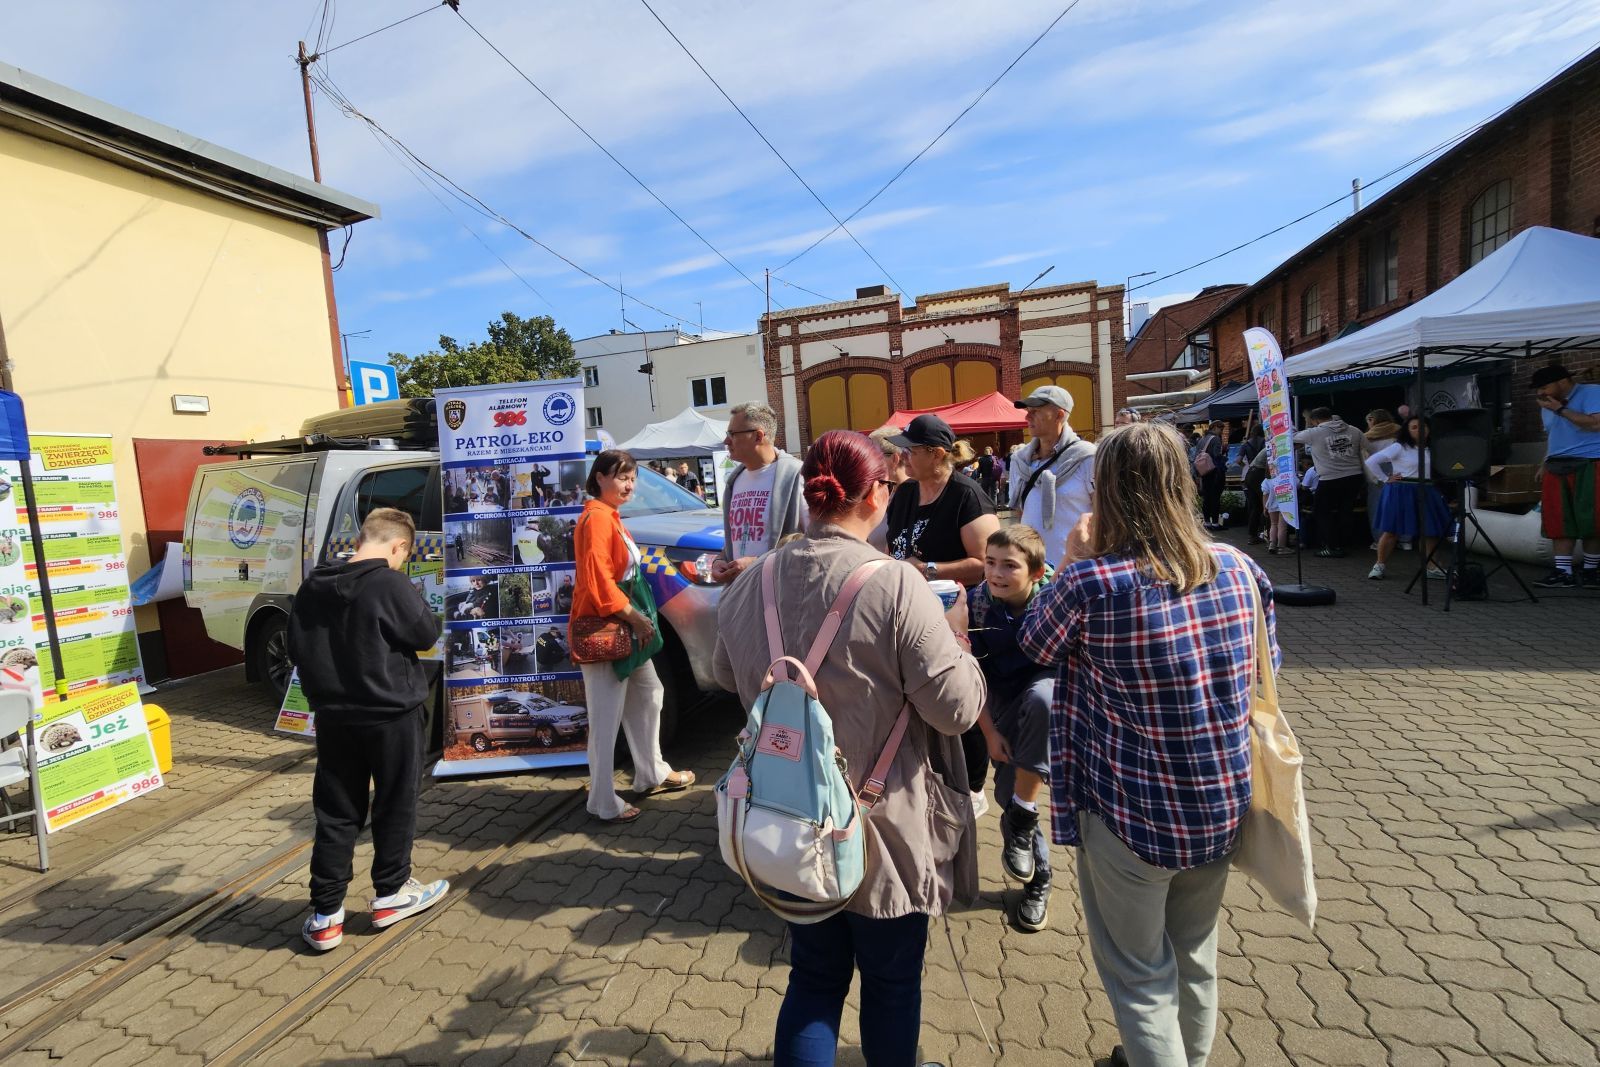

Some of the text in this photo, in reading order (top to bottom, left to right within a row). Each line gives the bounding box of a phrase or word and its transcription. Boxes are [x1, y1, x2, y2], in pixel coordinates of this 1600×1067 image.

[360, 367, 390, 405] P
[488, 403, 528, 411] ALARMOWY
[493, 410, 528, 428] 986
[455, 430, 564, 450] PATROL-EKO
[46, 449, 109, 460] ZWIERZĘCIA
[467, 449, 491, 457] RAZEM
[500, 445, 552, 455] MIESZKAŃCAMI
[48, 457, 97, 468] DZIKIEGO
[493, 457, 527, 465] EDUKACJA
[733, 492, 746, 500] WOULD
[746, 490, 757, 498] YOU
[737, 498, 753, 507] RIDE
[752, 498, 768, 506] THE
[97, 510, 118, 519] 986
[474, 509, 549, 520] OCHRONA ŚRODOWISKA
[0, 528, 26, 538] rna
[105, 561, 125, 570] 986
[481, 565, 548, 575] OCHRONA ZWIERZĄT
[0, 584, 32, 596] ając
[111, 607, 133, 617] 986
[481, 617, 552, 627] OCHRONA POWIETRZA
[483, 674, 556, 685] POJAZD PATROLU EKO
[86, 691, 135, 714] ZWIERZĘCIA
[88, 701, 126, 720] DZIKIEGO
[89, 715, 129, 740] Jeż
[131, 774, 160, 793] 986
